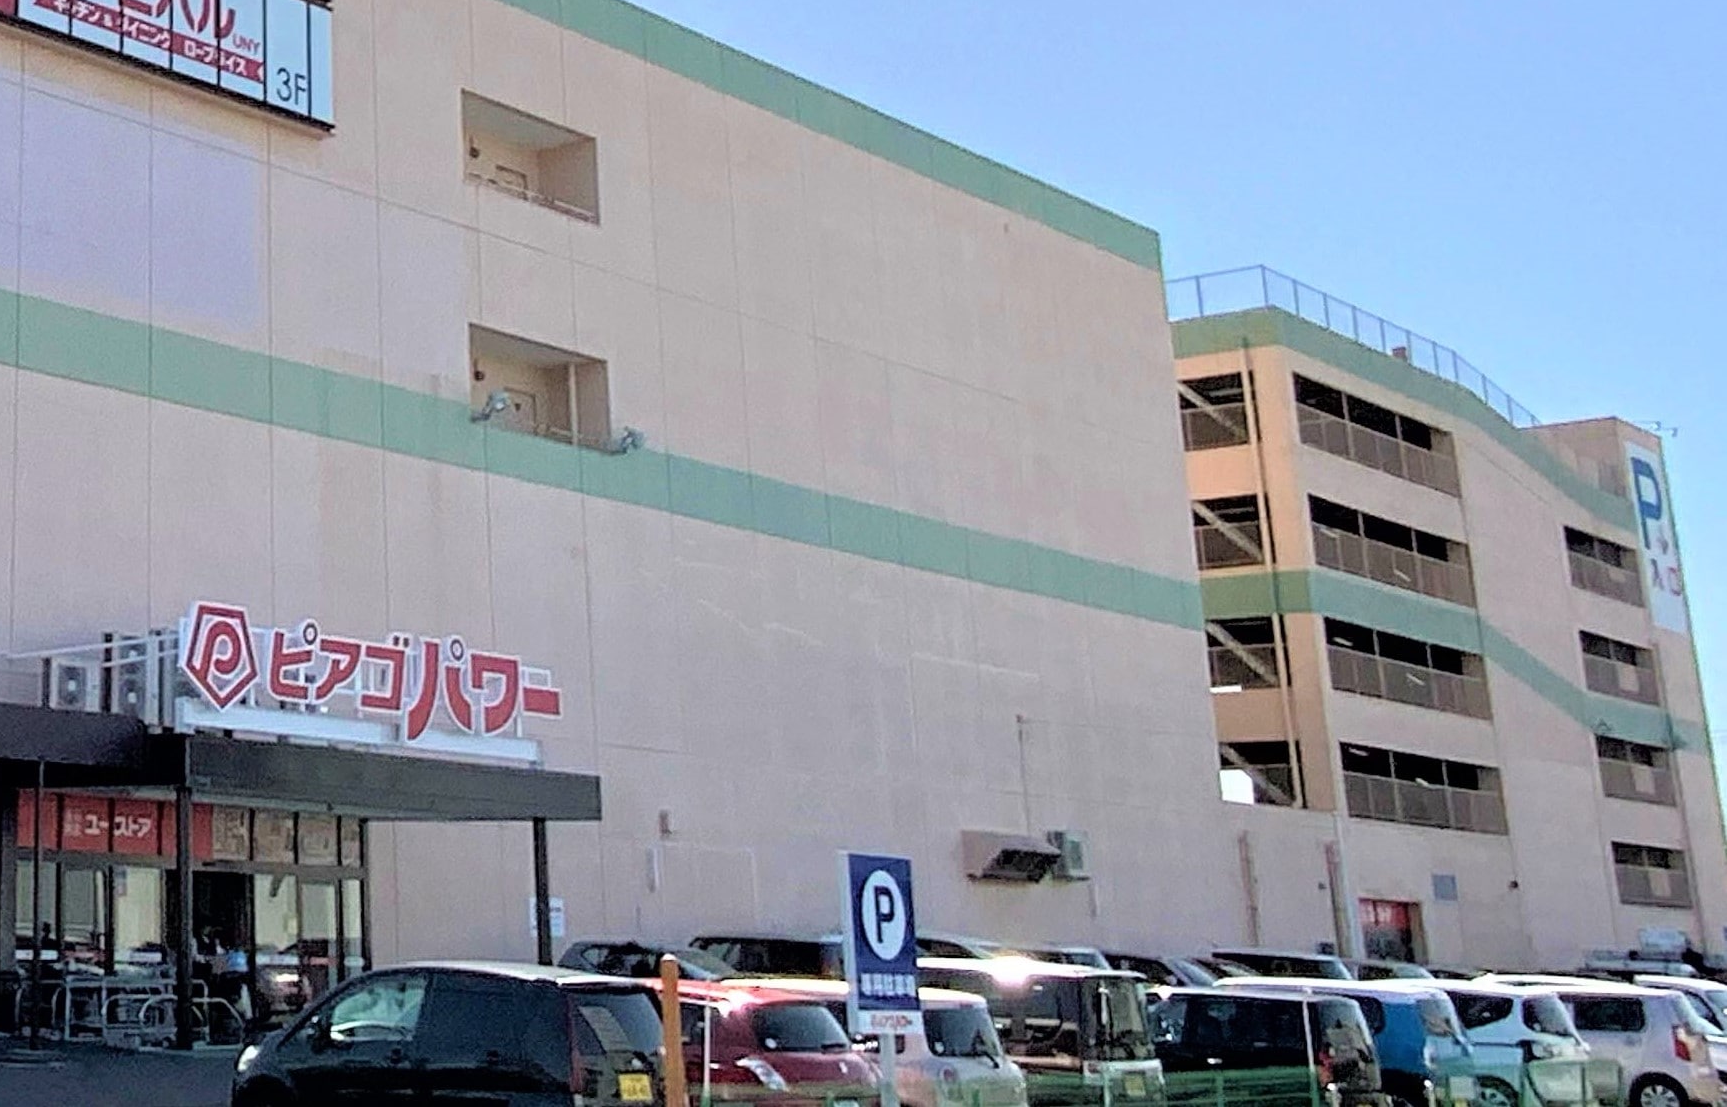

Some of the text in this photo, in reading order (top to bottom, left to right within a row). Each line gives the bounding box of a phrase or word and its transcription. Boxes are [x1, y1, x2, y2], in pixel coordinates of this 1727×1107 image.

[232, 33, 262, 55] UNY
[276, 67, 307, 105] 3F
[1630, 457, 1663, 551] P
[268, 618, 563, 742] ピアゴパワー
[84, 813, 152, 838] ユーストア
[874, 884, 895, 944] P
